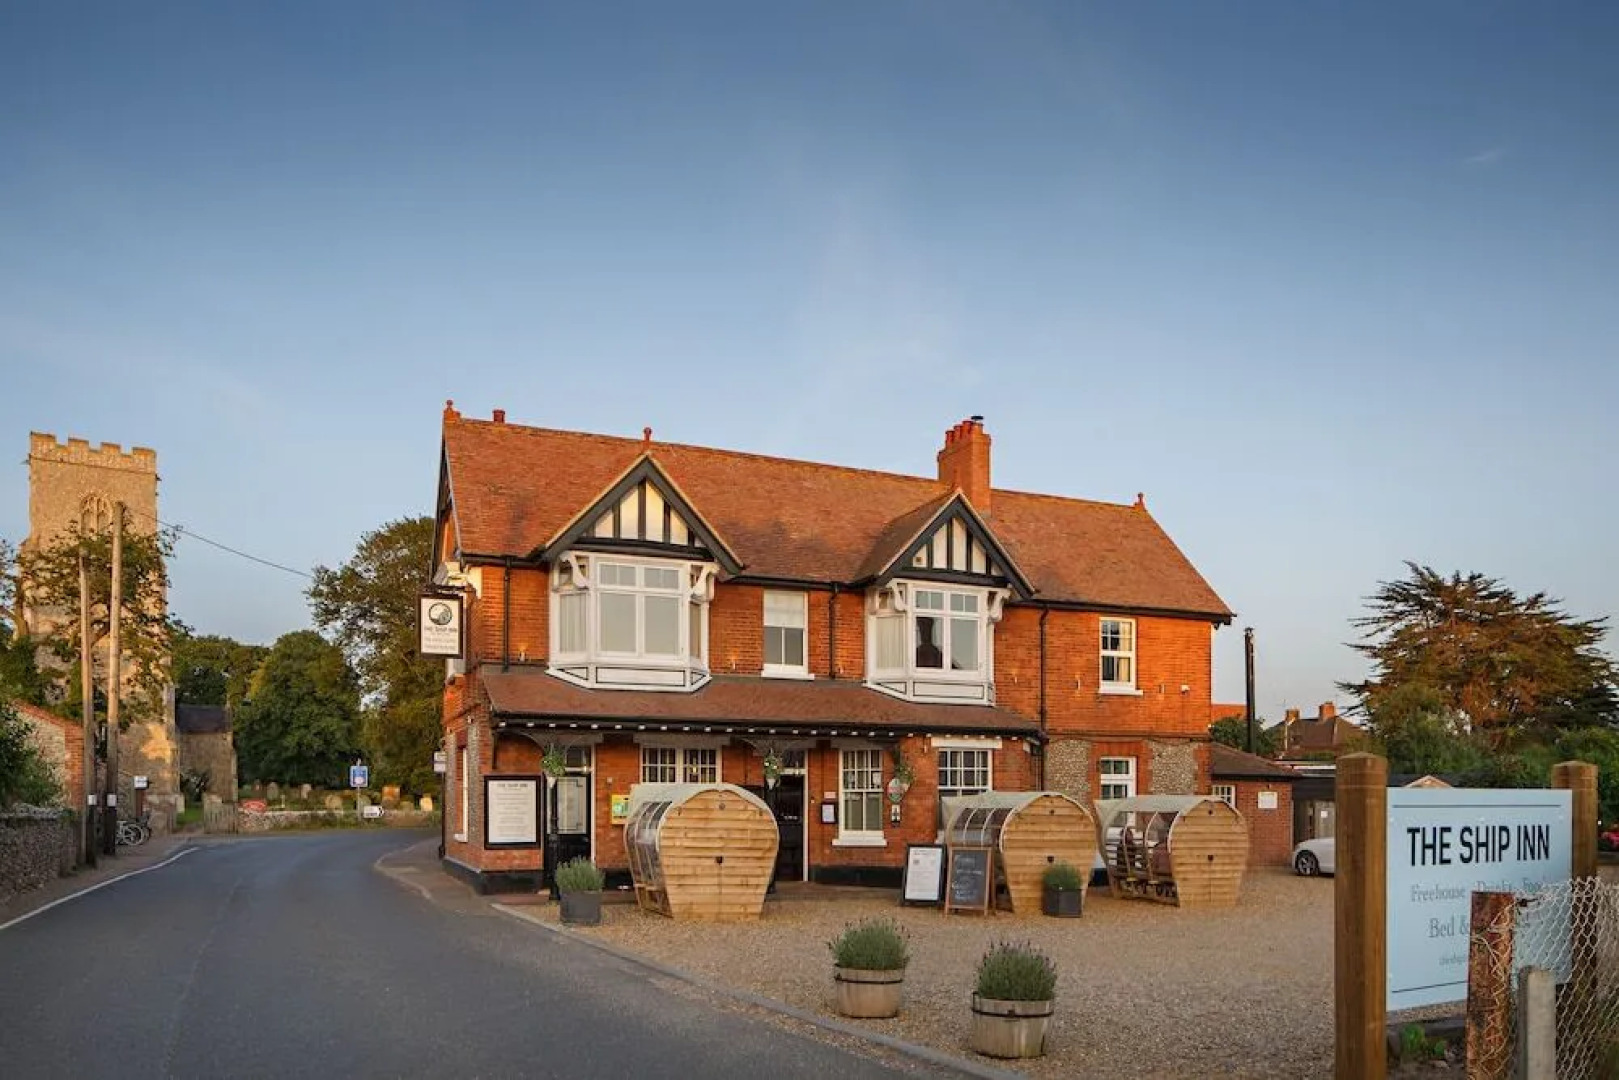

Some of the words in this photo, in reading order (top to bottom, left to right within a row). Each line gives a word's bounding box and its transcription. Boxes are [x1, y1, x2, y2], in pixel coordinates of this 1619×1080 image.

[1407, 826, 1452, 867] THE
[1459, 825, 1510, 864] SHIP
[1516, 824, 1550, 861] INN
[1429, 914, 1455, 938] Bed
